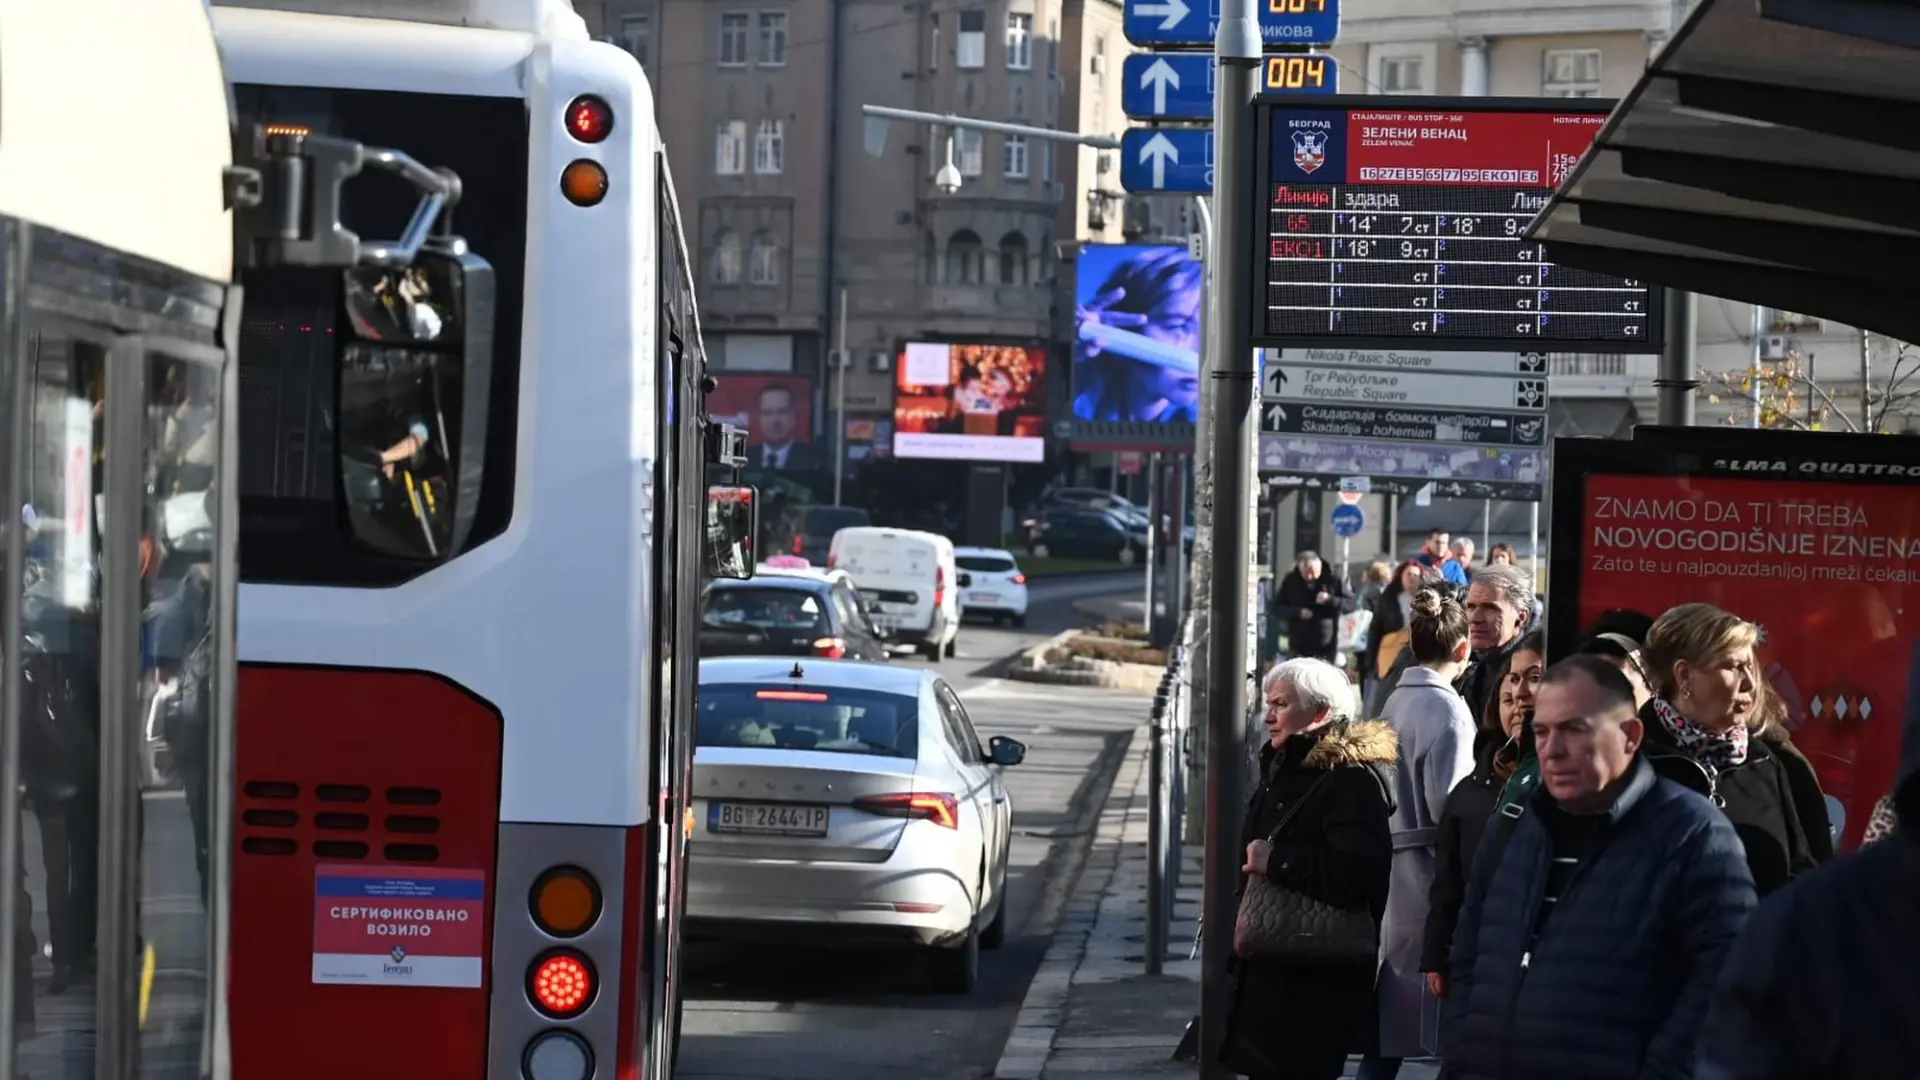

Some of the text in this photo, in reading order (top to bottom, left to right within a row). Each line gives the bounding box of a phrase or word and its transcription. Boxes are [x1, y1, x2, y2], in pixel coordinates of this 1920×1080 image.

[1267, 58, 1325, 88] 004
[1288, 120, 1332, 129] БЕОГРАД
[1582, 117, 1608, 125] ЛИНИ
[1361, 127, 1467, 141] ЗЕЛЕНИ ВЕНАЦ
[1362, 168, 1377, 179] 16
[1407, 169, 1422, 180] 35
[1426, 169, 1440, 180] 65
[1444, 170, 1459, 180] 77
[1463, 170, 1478, 180] 95
[1275, 186, 1329, 206] Линија
[1345, 193, 1400, 209] здара
[1287, 214, 1310, 231] 65
[1413, 273, 1429, 282] ст
[1517, 275, 1532, 284] ст
[1413, 297, 1428, 307] ст
[1516, 300, 1532, 309] ст
[1623, 301, 1639, 310] ст
[1412, 322, 1428, 331] ст
[1516, 323, 1531, 333] ст
[1623, 326, 1639, 335] ст
[1305, 350, 1432, 367] Nikola Pasic Square
[1302, 384, 1408, 400] Republic Square
[1372, 424, 1433, 438] bohemian
[1799, 461, 1920, 477] QUATTRO
[1594, 496, 1868, 528] ZNAMO DA TI TREBA
[1594, 525, 1920, 559] NOVOGODIŠNJE IZNENA
[1592, 554, 1634, 572] Zato
[1639, 557, 1656, 573] te
[1660, 560, 1672, 573] u
[1676, 557, 1807, 581] najpouzdanijoj
[1812, 562, 1861, 581] mreži
[722, 805, 743, 824] BG
[330, 906, 469, 922] СЕРТИФИКОВАНО
[367, 923, 431, 937] ВОЗИЛО
